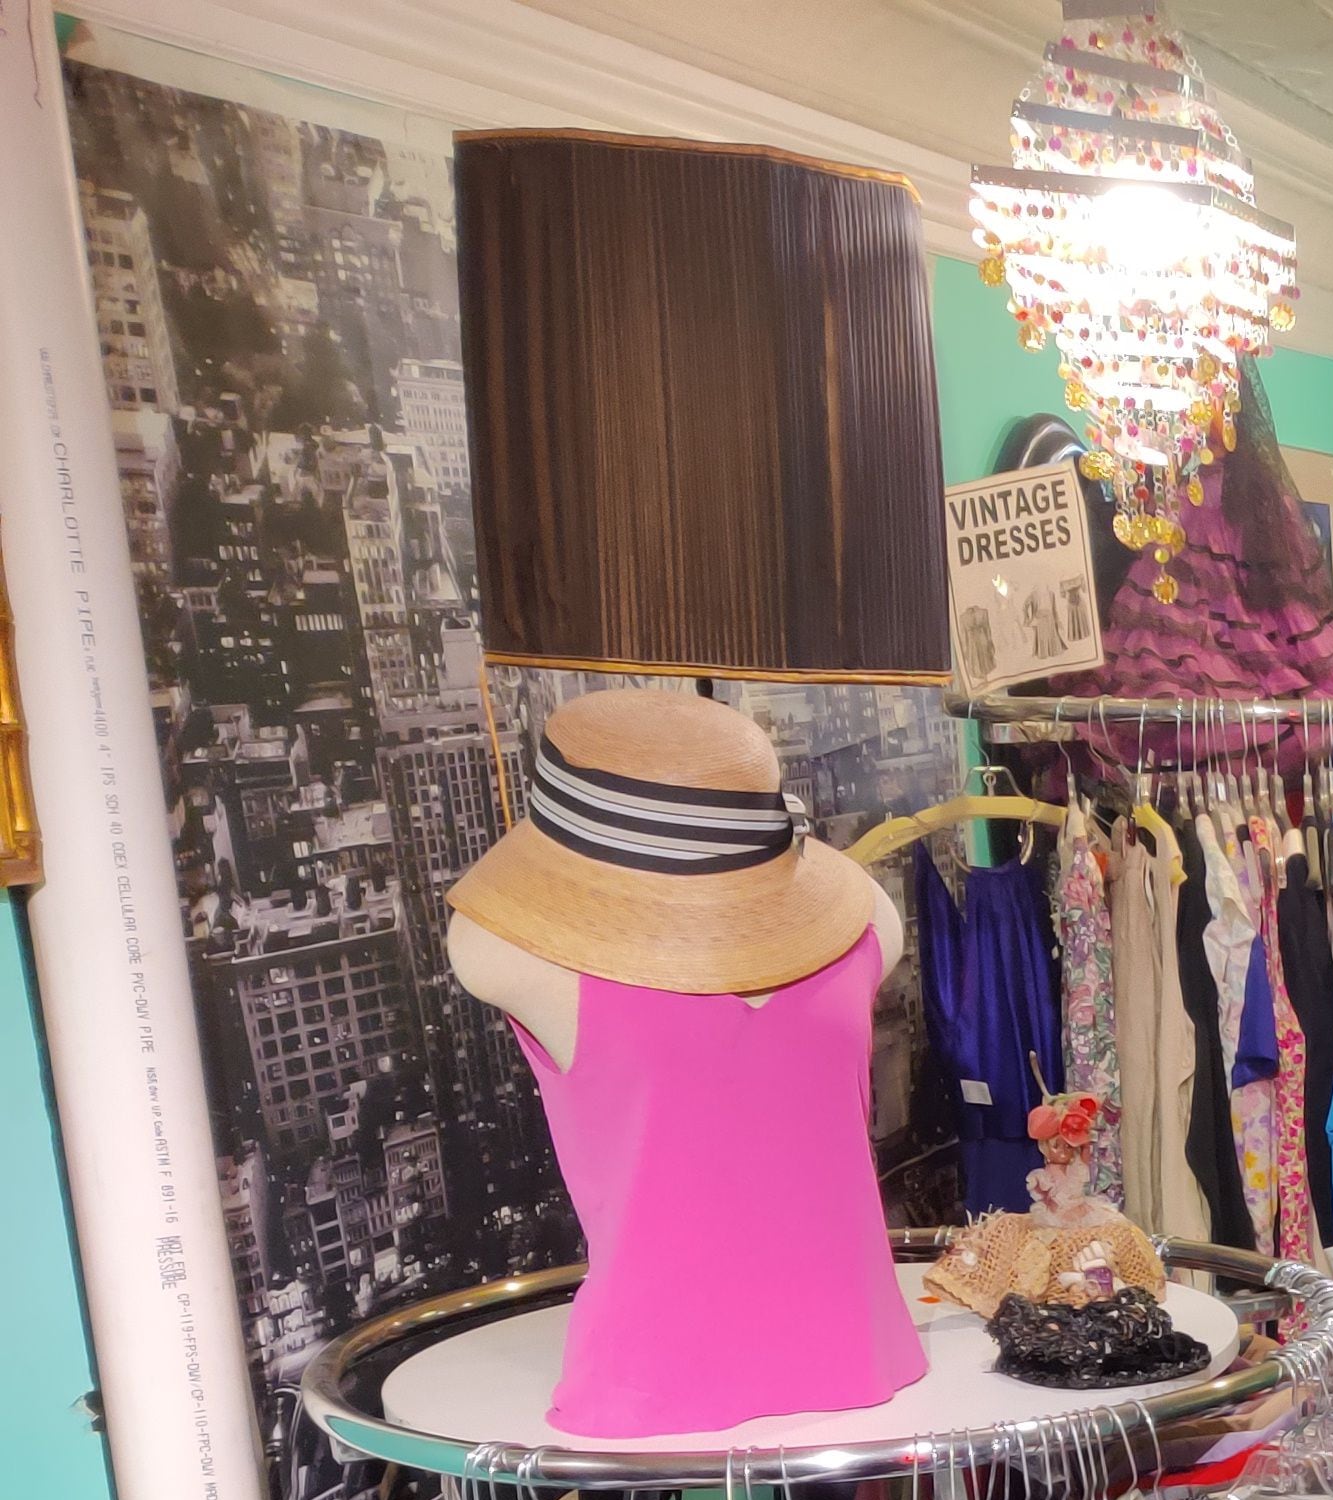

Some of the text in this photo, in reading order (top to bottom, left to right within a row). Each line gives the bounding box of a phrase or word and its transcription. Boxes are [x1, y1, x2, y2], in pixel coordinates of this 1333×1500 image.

[52, 441, 86, 574] CHARLOTTE
[949, 479, 1069, 531] VINTAGE
[957, 515, 1071, 567] DRESSES
[75, 590, 97, 647] PIPE
[104, 794, 120, 814] SCH
[109, 821, 123, 835] 40
[117, 876, 137, 932] CELLULAR
[126, 937, 142, 965] CORE
[138, 1025, 154, 1053] PIPE
[155, 1138, 170, 1166] ASTM
